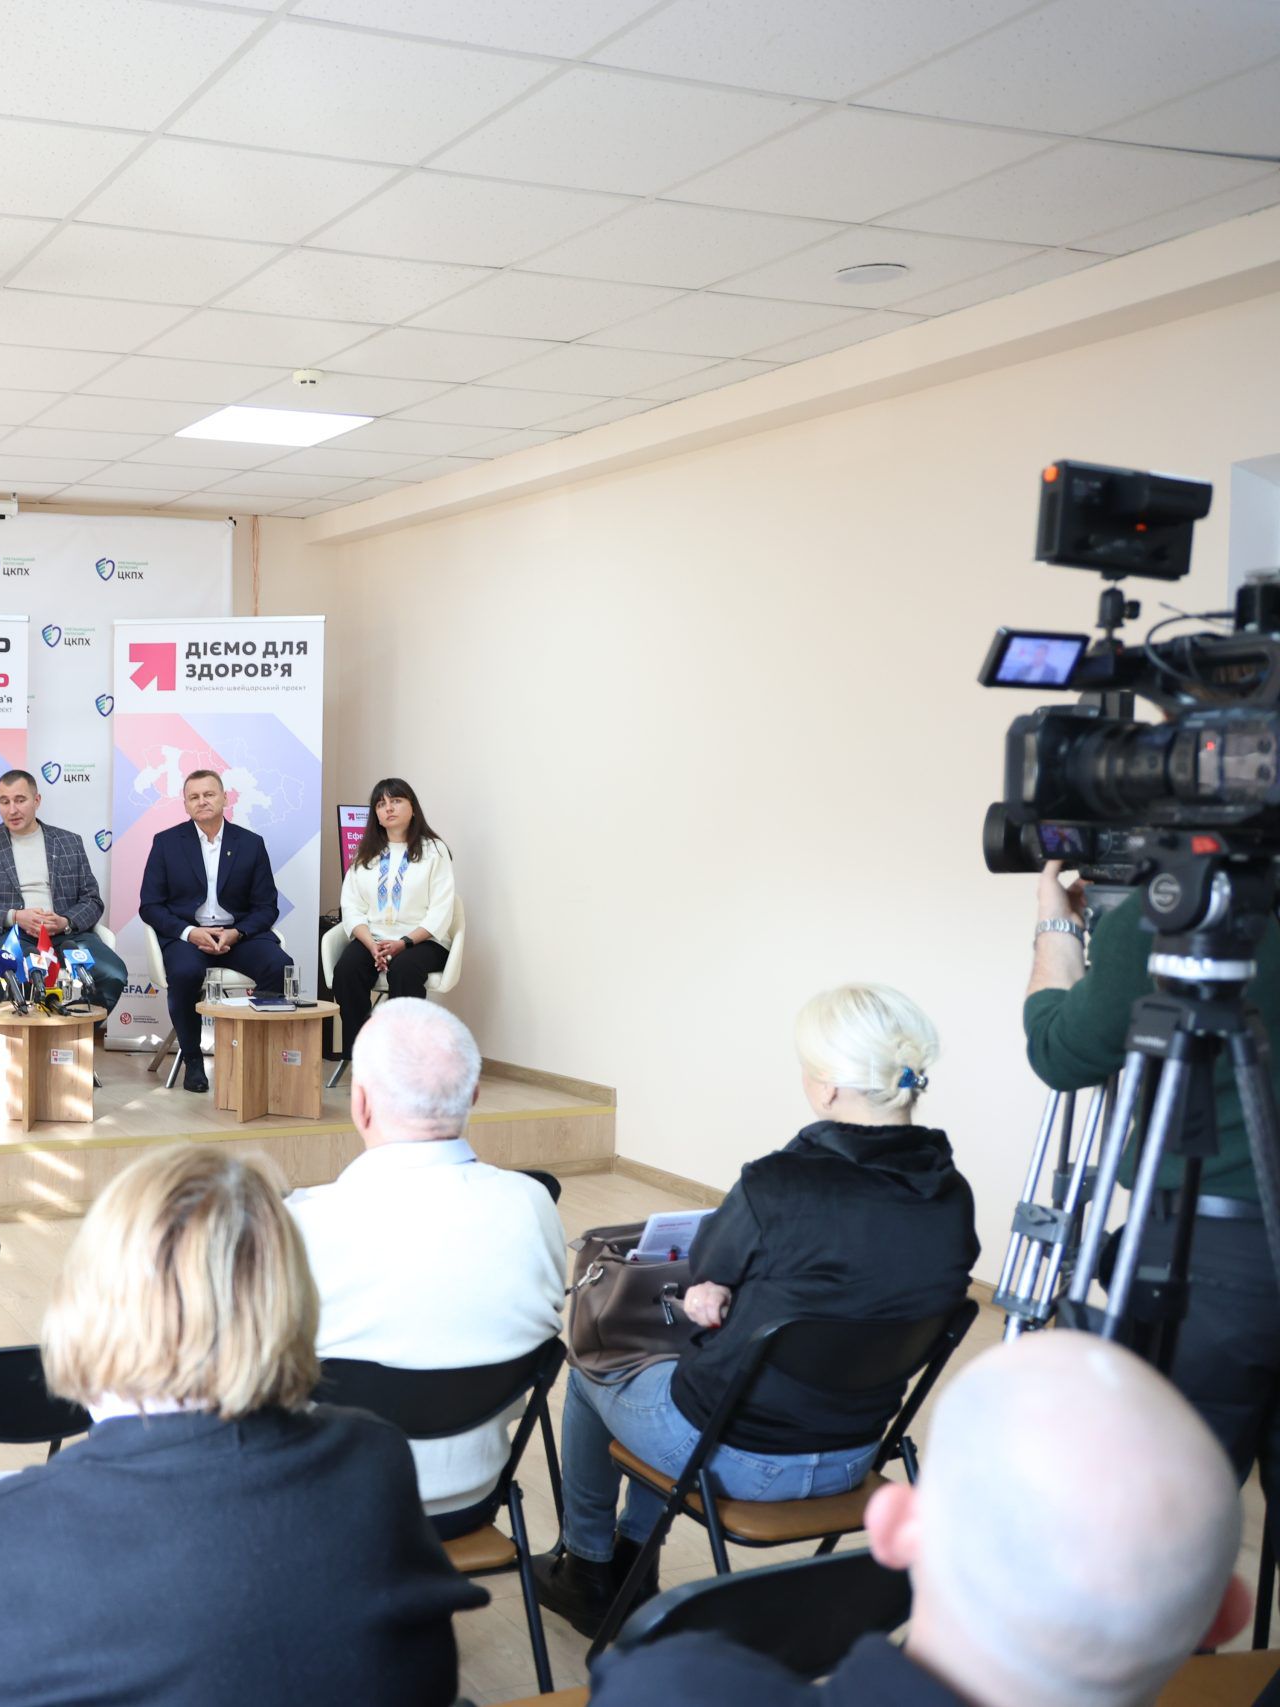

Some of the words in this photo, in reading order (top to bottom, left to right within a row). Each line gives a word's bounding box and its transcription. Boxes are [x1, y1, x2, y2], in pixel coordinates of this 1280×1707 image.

[2, 567, 30, 577] ЦКПХ
[117, 571, 144, 580] ЦКПХ
[64, 637, 91, 646] ЦКПХ
[185, 641, 257, 659] ДІЄМО
[262, 641, 308, 659] ДЛЯ
[63, 774, 90, 783] ЦКПХ
